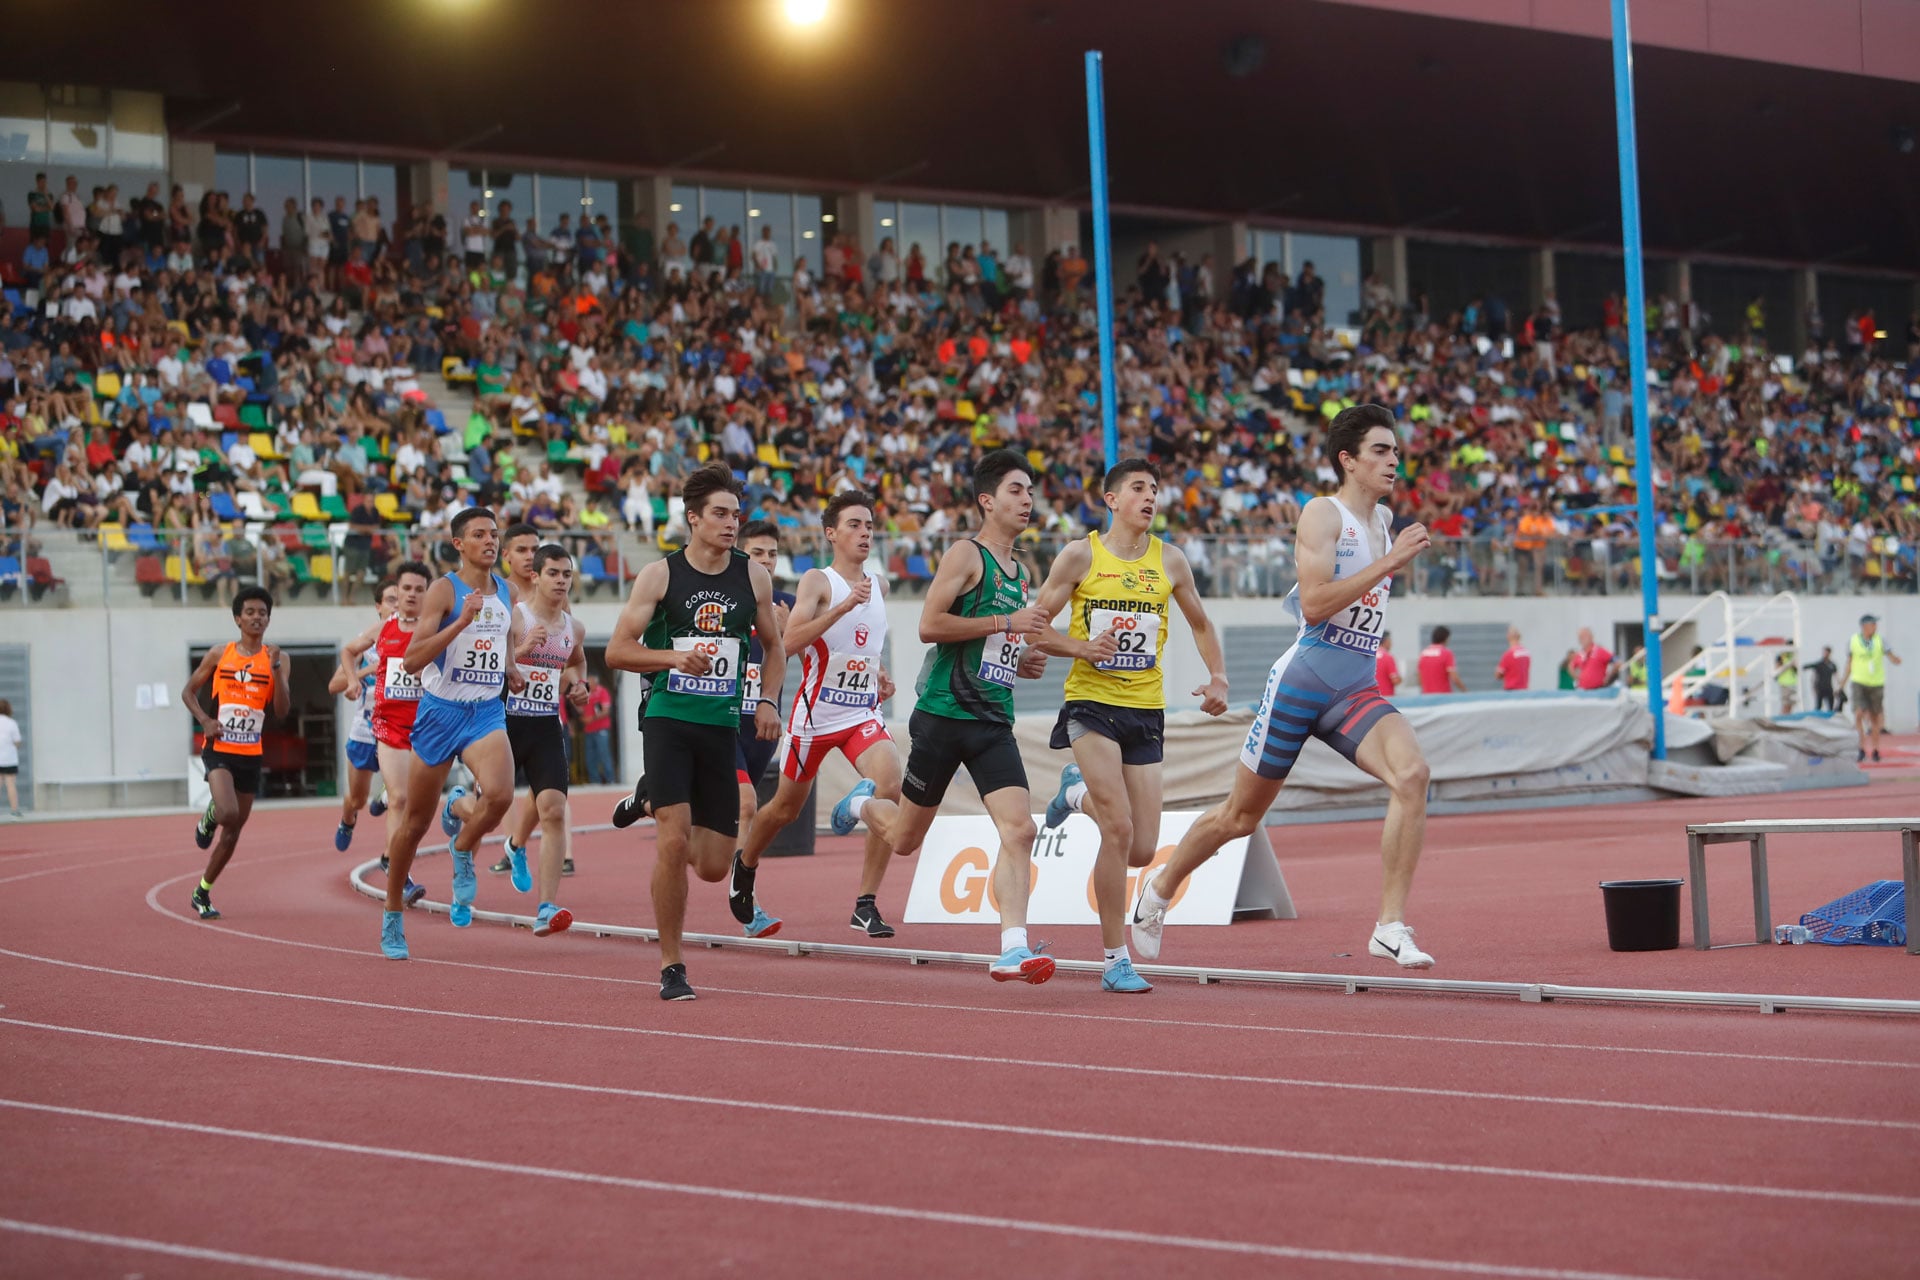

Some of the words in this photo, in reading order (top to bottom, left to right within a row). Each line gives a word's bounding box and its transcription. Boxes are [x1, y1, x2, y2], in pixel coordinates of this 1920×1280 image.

[1362, 591, 1379, 608] GO
[1112, 616, 1137, 630] GO
[1349, 605, 1383, 634] 127
[474, 639, 492, 651] GO
[694, 642, 719, 655] GO
[1103, 630, 1147, 653] 62
[463, 650, 499, 670] 318
[1000, 643, 1020, 668] 86
[847, 660, 866, 672] GO
[529, 671, 548, 682] GO
[837, 671, 870, 692] 144
[523, 681, 553, 701] 168
[233, 708, 251, 718] GO
[225, 717, 256, 732] 442
[1034, 823, 1068, 857] fit
